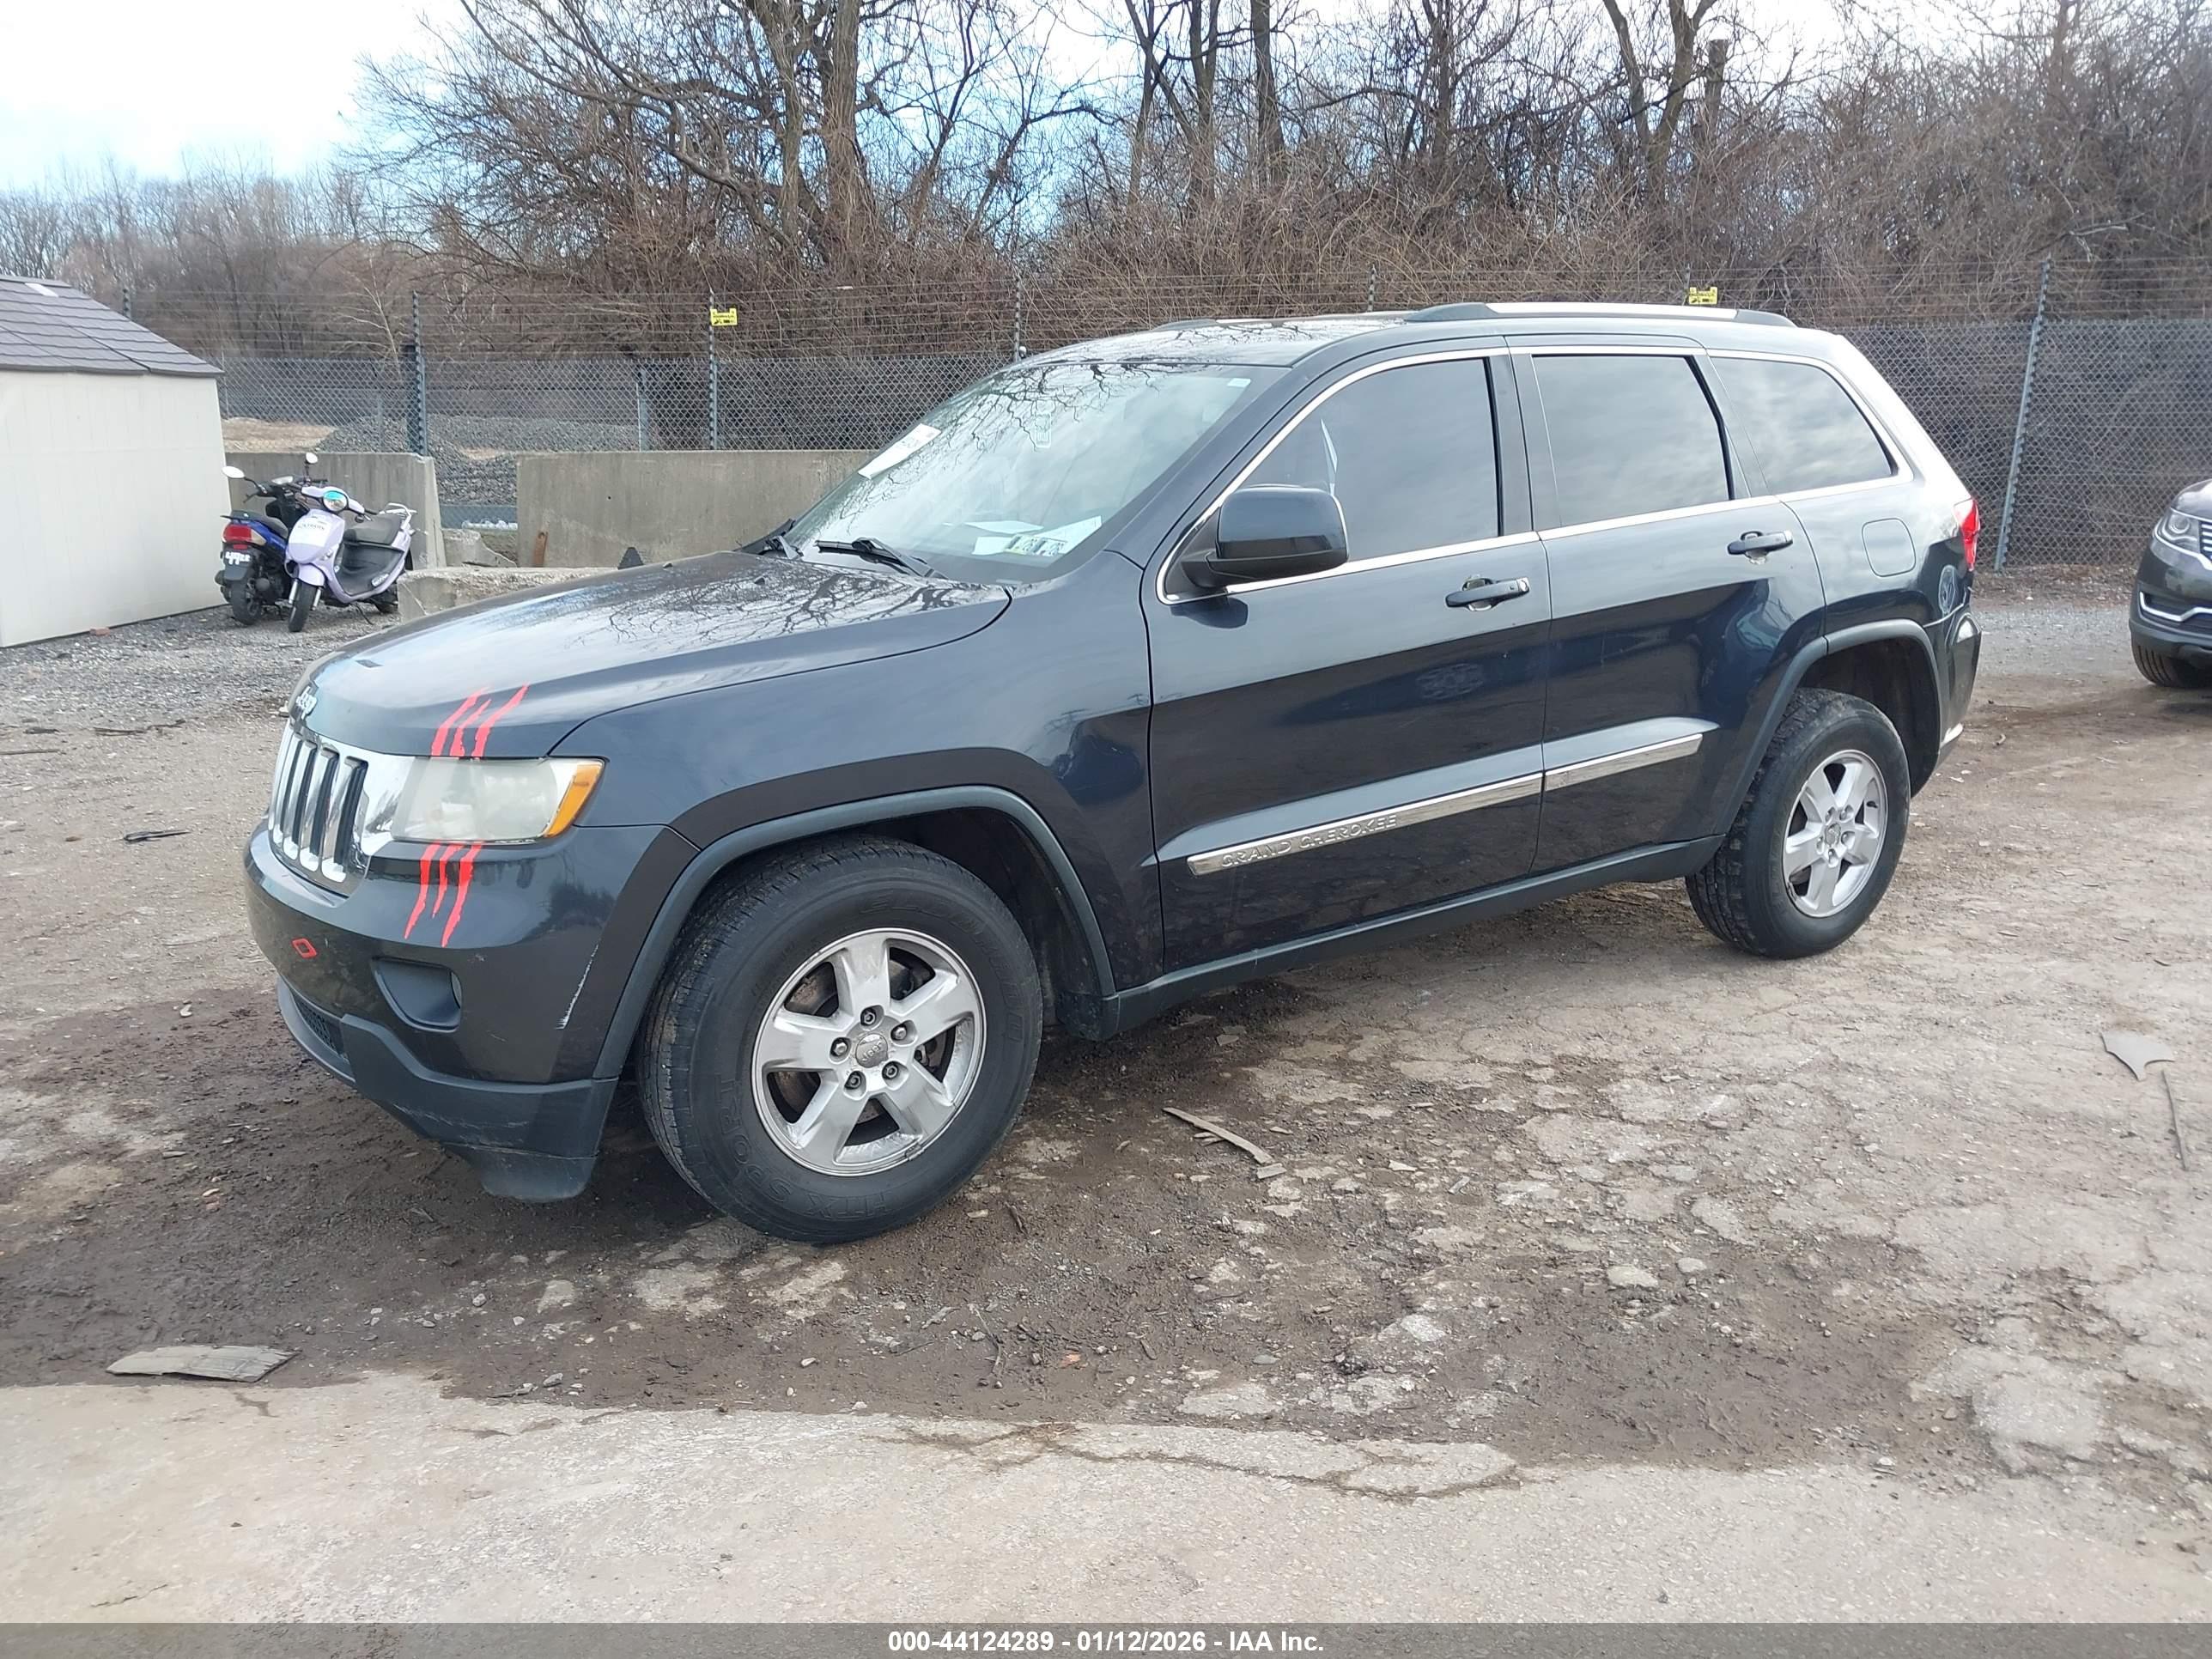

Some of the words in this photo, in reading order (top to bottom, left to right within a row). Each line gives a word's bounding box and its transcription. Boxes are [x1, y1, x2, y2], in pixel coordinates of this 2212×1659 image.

[1221, 840, 1292, 868] GRAND
[1298, 814, 1398, 849] CHEROKEE
[714, 1073, 794, 1204] SPORT
